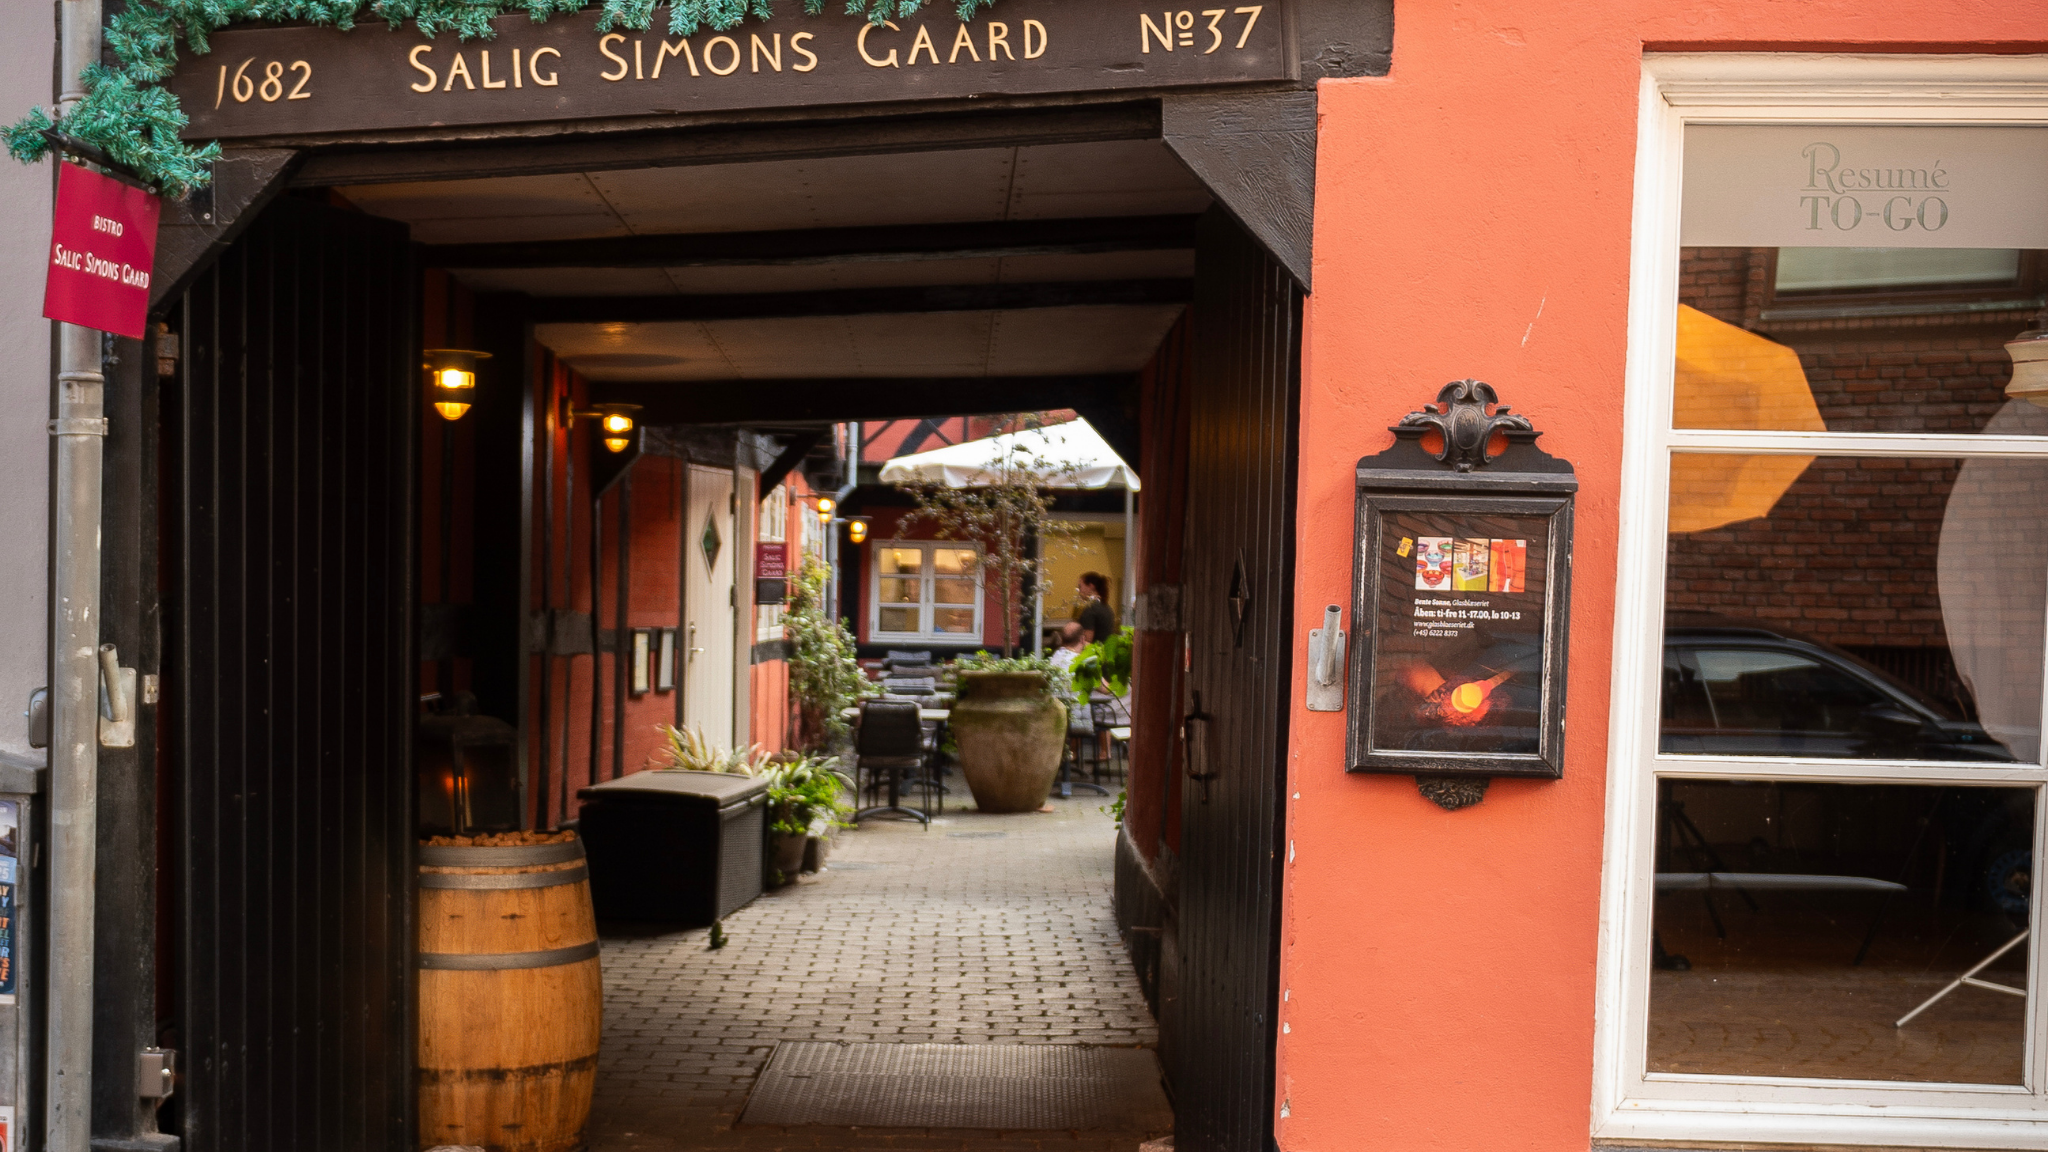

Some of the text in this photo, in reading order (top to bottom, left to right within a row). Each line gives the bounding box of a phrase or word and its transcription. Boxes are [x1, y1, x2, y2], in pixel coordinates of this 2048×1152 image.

[214, 57, 312, 110] 1682
[409, 45, 562, 93] SALIG
[599, 32, 818, 81] SIMONS
[857, 19, 1048, 68] GAARD
[1801, 142, 1950, 195] Resumé
[93, 215, 124, 237] BISTRO
[1800, 195, 1949, 231] TO-GO
[55, 243, 150, 289] SALIG SIMONS GAARD
[1413, 606, 1436, 617] Åben:
[1437, 608, 1457, 618] ti-fre
[1500, 611, 1521, 620] 10-13
